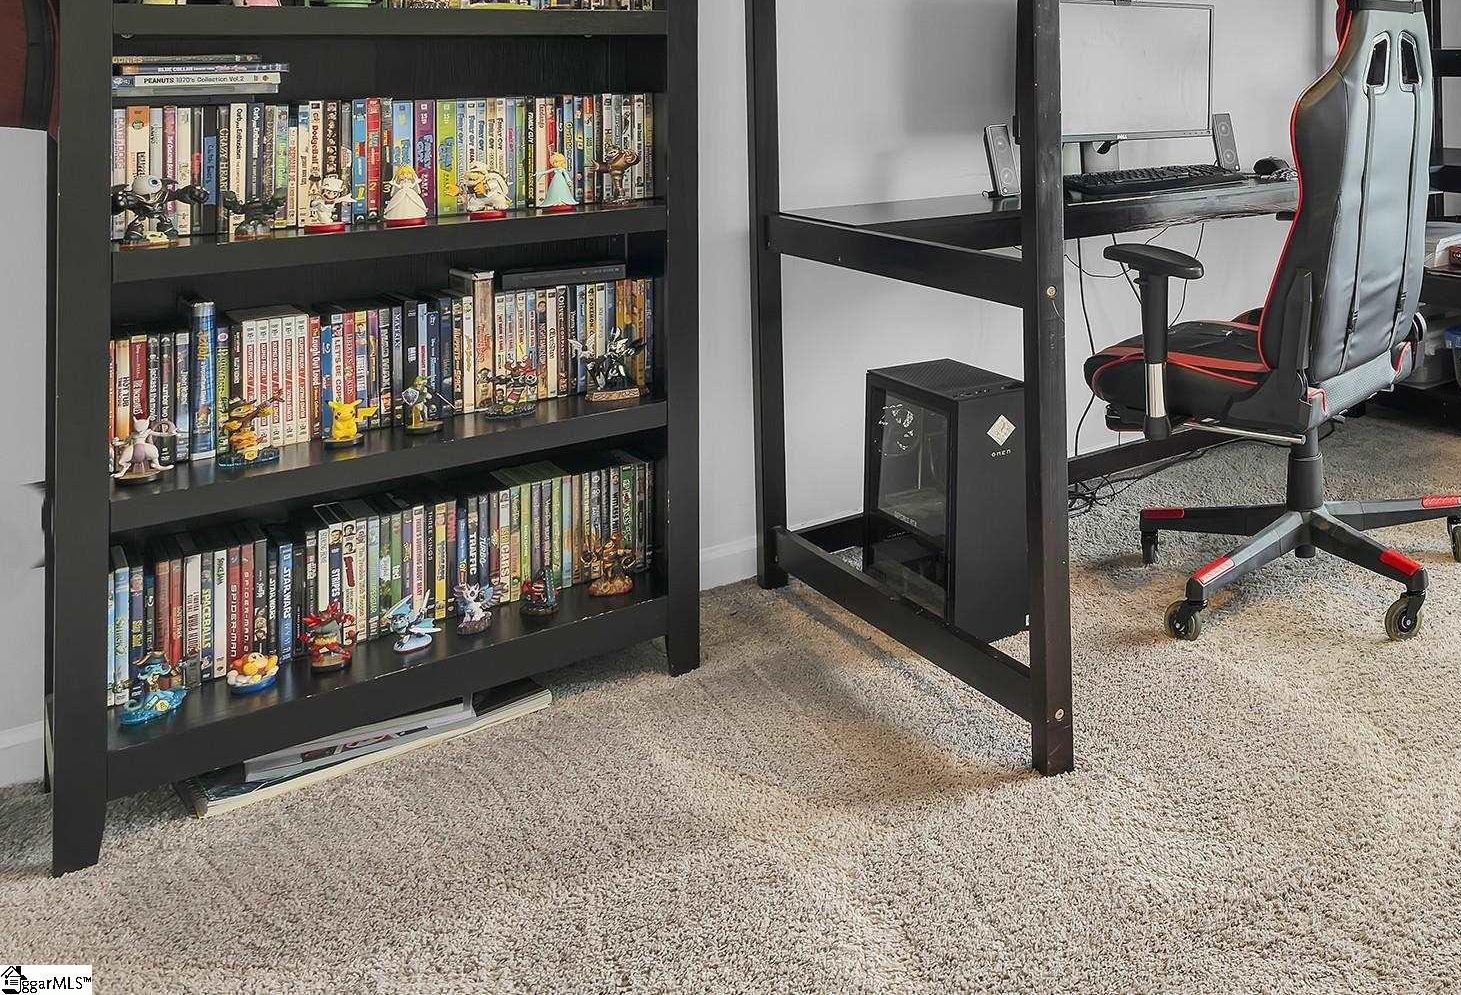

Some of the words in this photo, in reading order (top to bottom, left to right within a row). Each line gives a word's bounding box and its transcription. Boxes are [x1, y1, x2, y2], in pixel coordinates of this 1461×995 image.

[219, 127, 229, 159] CRAZY
[219, 161, 228, 193] HEART
[310, 336, 320, 356] Laugh
[312, 357, 320, 369] Out
[336, 365, 341, 377] BE
[148, 368, 158, 392] jackass
[312, 370, 320, 385] Loud
[392, 565, 400, 579] ted
[500, 545, 510, 577] CARS
[283, 567, 292, 592] STAR
[332, 568, 340, 597] STRIPES
[283, 592, 292, 618] WARS
[202, 588, 212, 649] SPACEBALLS
